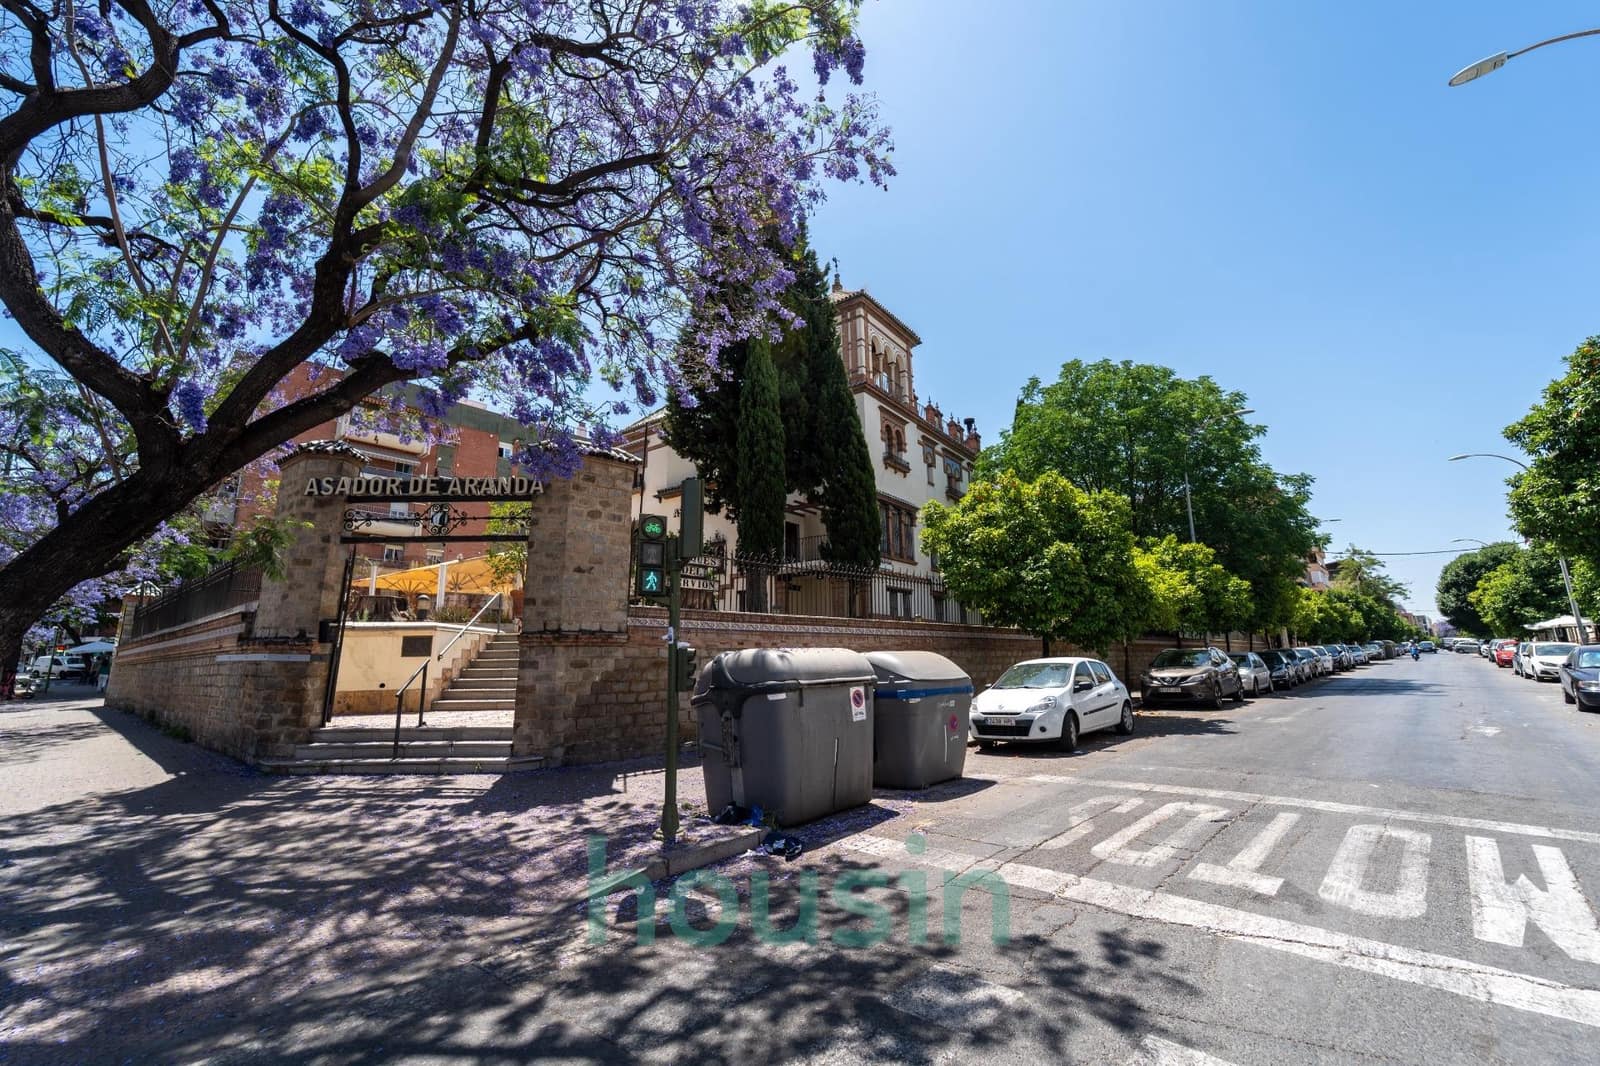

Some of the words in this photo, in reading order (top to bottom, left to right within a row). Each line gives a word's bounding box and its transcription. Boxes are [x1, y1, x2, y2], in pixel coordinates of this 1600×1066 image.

[304, 476, 402, 496] ASADOR
[408, 476, 441, 495] DE
[449, 476, 545, 495] ARANDA
[1020, 798, 1600, 966] MOTOS
